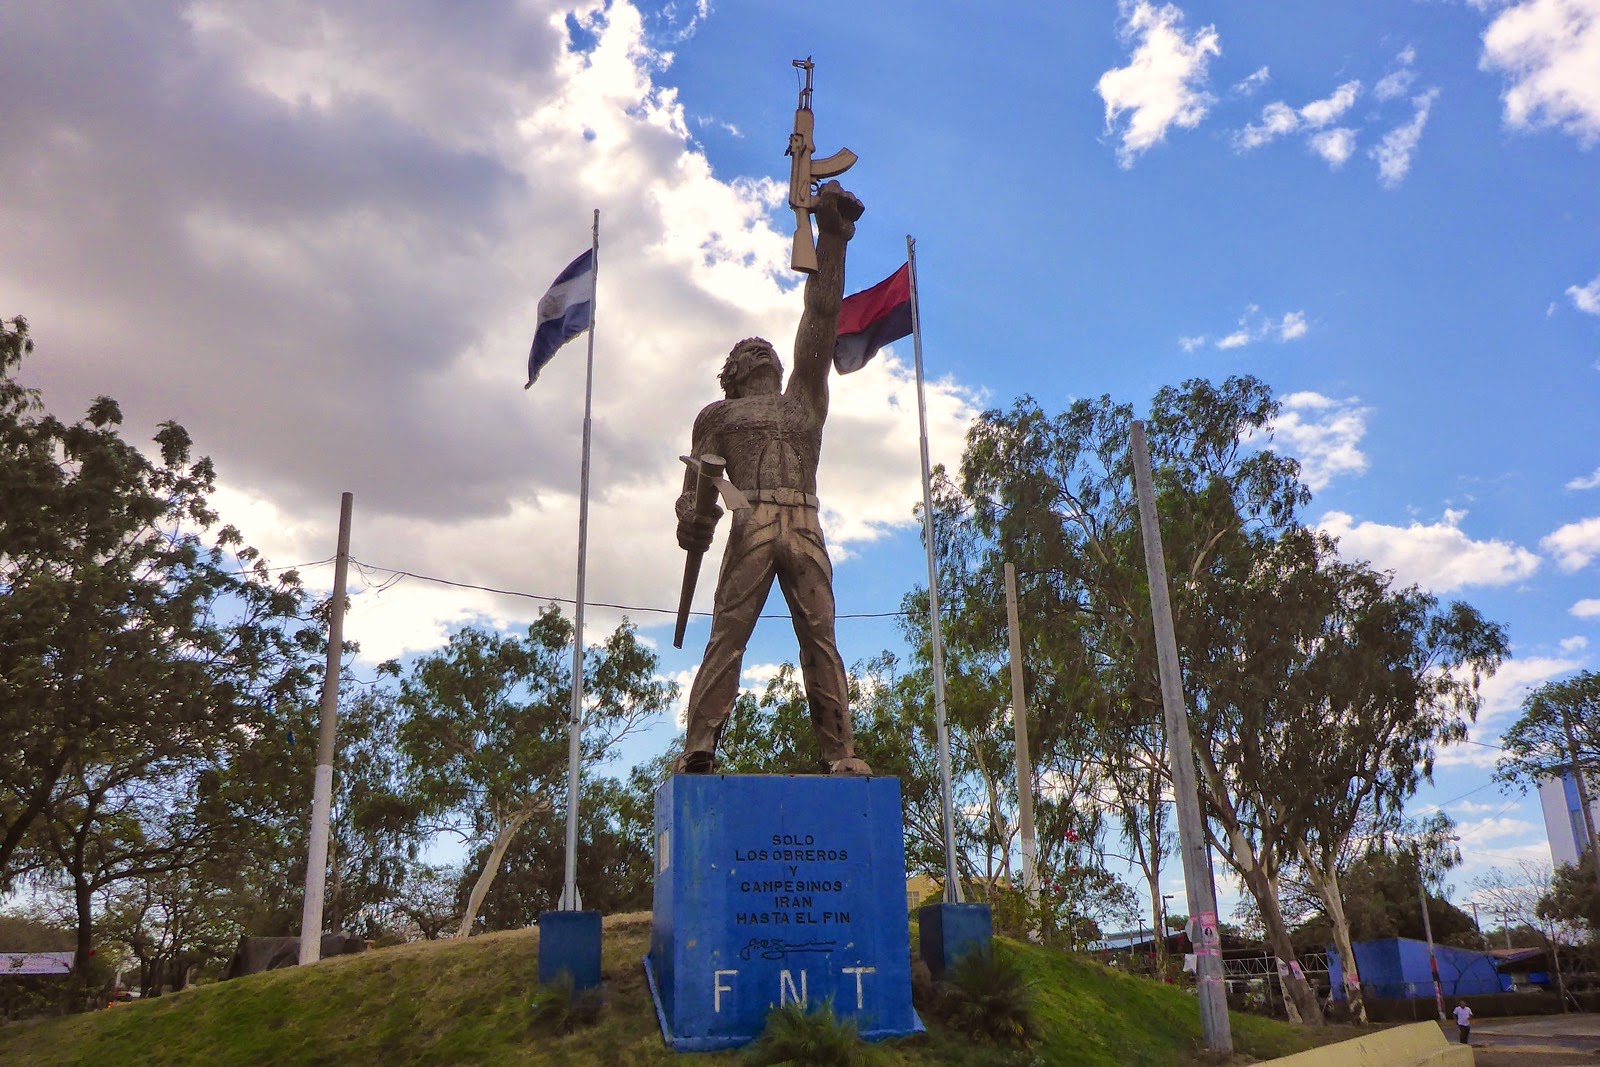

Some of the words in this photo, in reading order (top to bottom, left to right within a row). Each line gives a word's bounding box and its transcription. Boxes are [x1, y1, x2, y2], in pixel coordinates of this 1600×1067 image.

[772, 834, 815, 846] SOLO
[735, 850, 768, 861] LOS
[772, 850, 848, 861] OBREROS
[789, 865, 798, 877] Y
[740, 881, 843, 892] CAMPESINOS
[774, 896, 812, 908] IRAN
[736, 911, 789, 924] HASTA
[796, 911, 817, 924] EL
[823, 911, 850, 924] FIN
